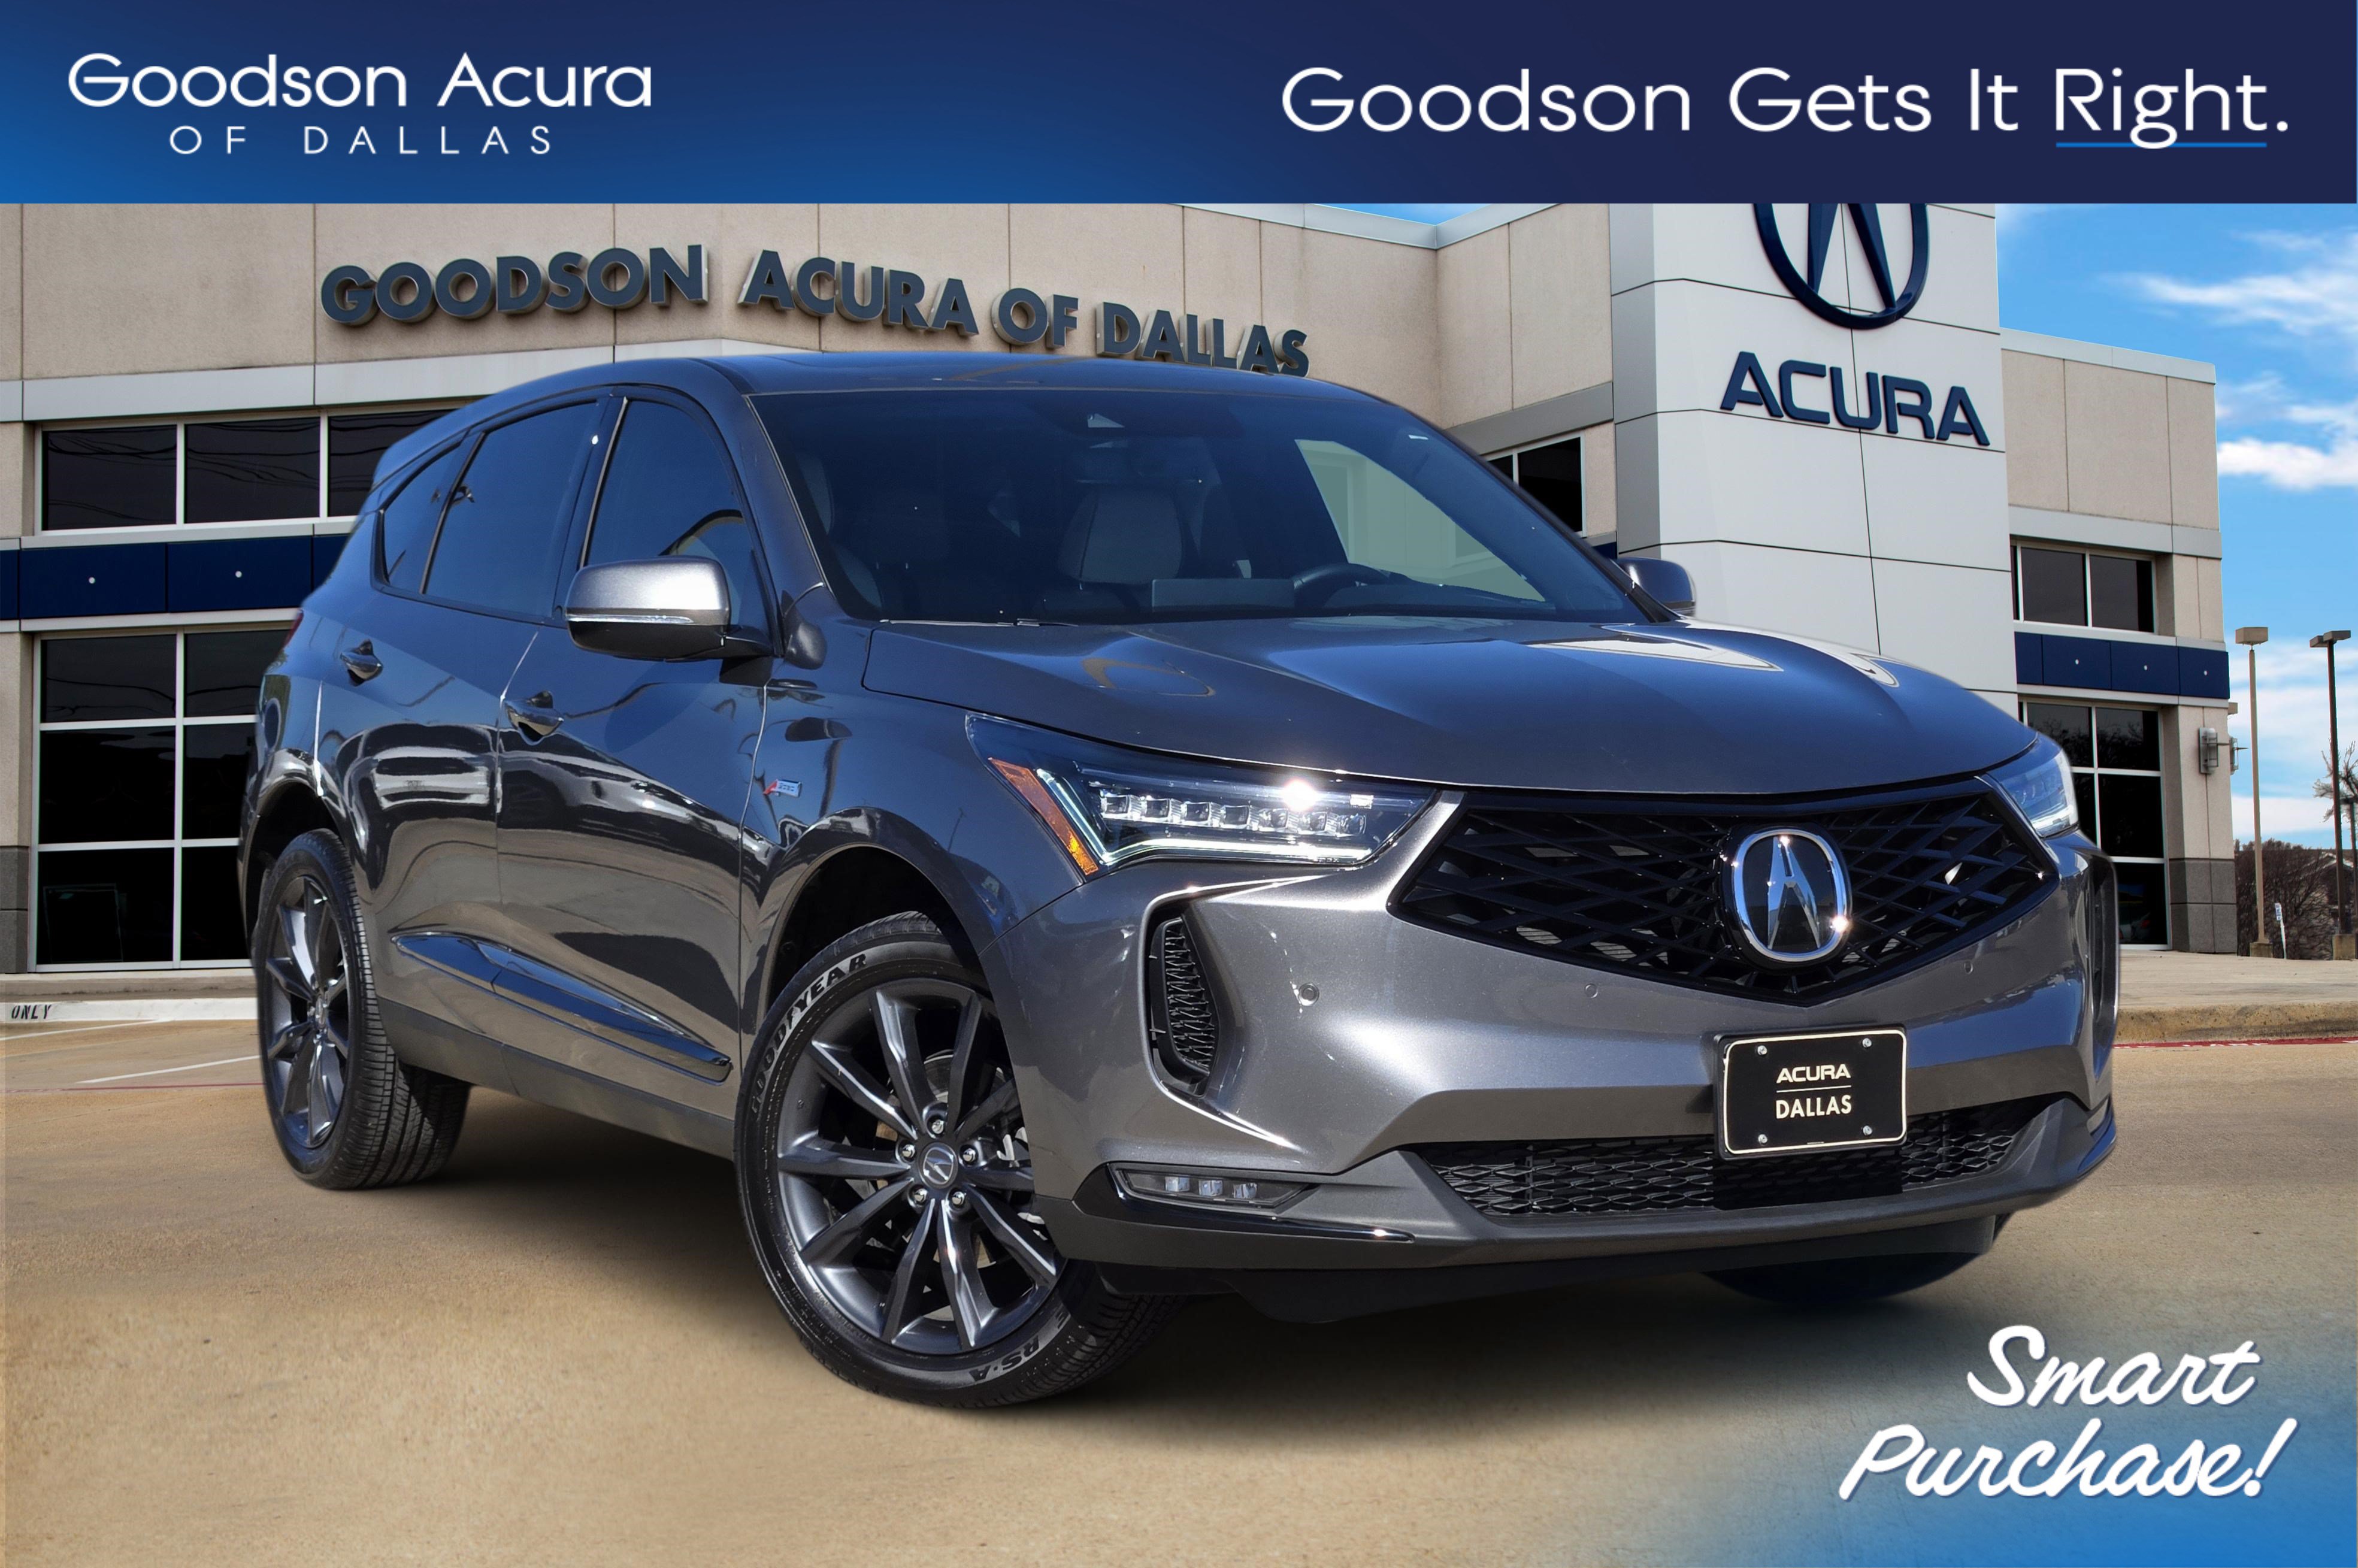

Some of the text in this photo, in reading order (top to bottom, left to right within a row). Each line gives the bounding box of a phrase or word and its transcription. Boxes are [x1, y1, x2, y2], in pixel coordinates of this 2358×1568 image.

[320, 245, 1310, 377] GOODSON ACURA OF DALLAS
[1720, 351, 1990, 446] ACURA
[11, 1004, 52, 1019] ONLY
[1776, 1064, 1851, 1083] ACURA
[1776, 1095, 1852, 1119] DALLAS
